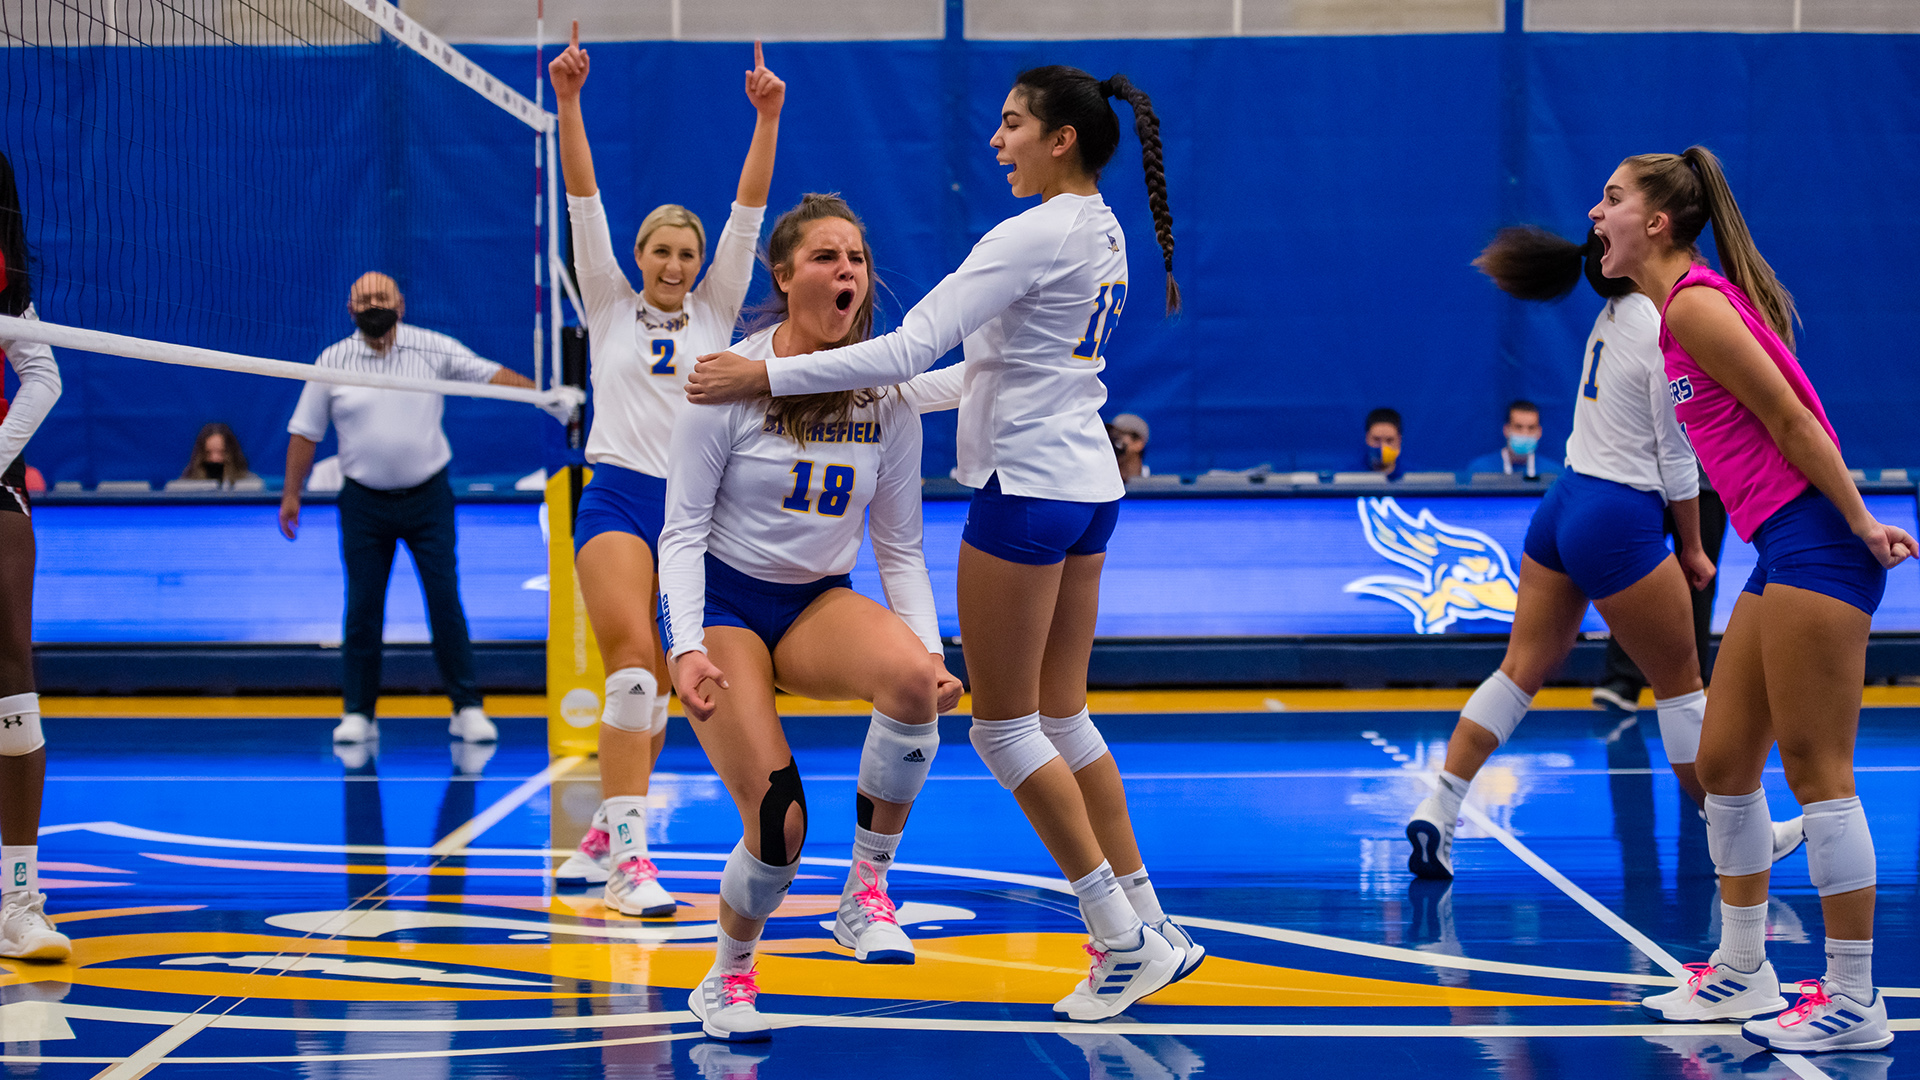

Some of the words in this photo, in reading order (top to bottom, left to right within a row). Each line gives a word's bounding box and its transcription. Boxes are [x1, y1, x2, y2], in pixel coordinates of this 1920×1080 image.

[650, 338, 677, 377] 2
[1583, 339, 1605, 402] 1
[1669, 375, 1694, 406] RS
[781, 460, 856, 518] 18
